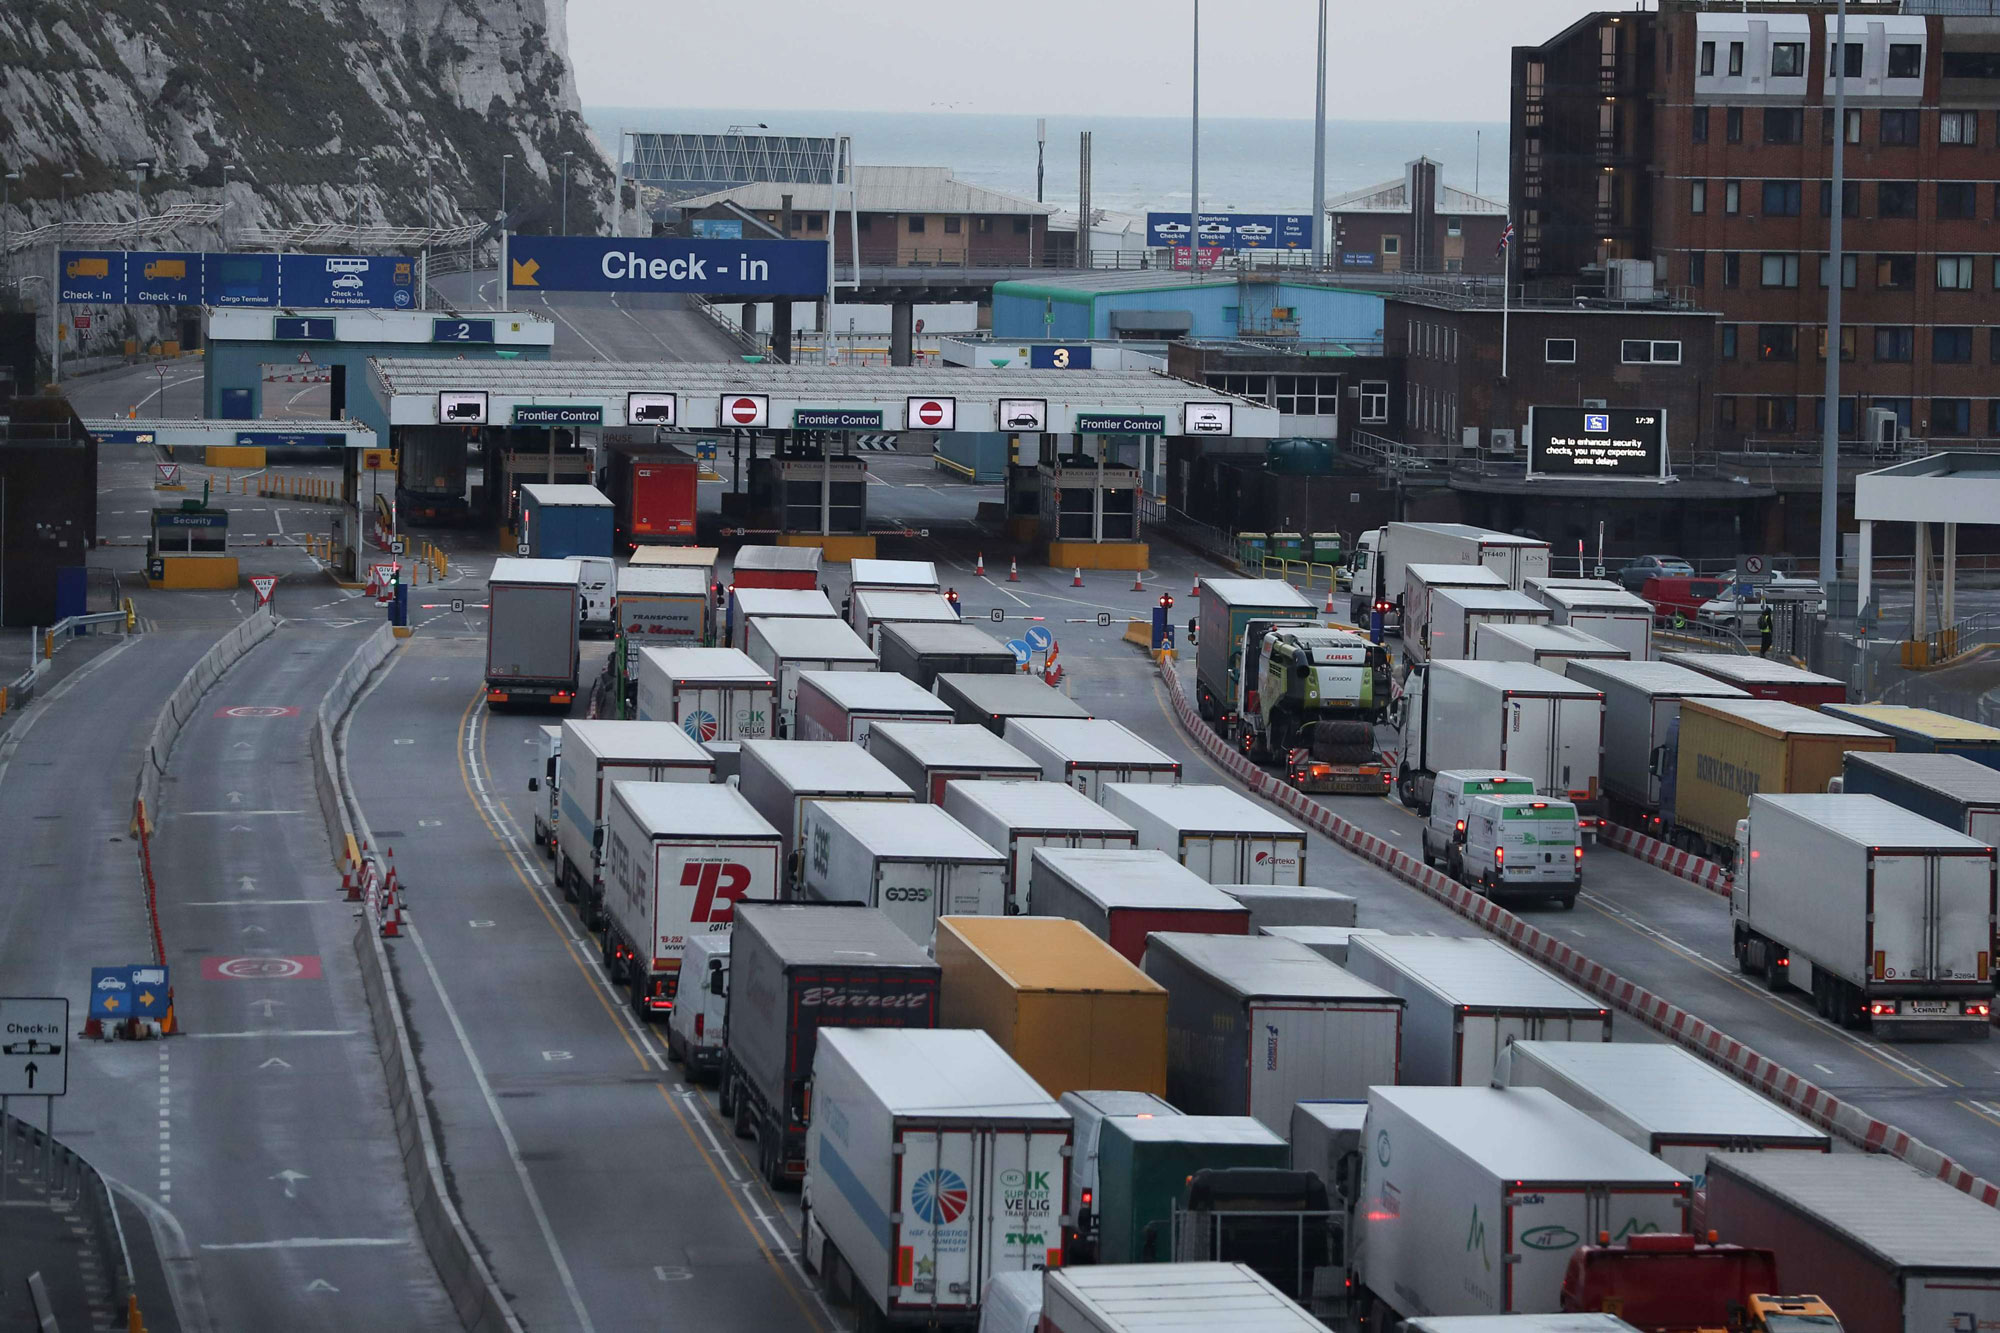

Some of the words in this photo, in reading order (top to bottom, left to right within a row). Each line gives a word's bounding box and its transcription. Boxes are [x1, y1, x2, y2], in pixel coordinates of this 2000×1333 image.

[601, 251, 707, 280] Check
[740, 253, 768, 281] in
[62, 290, 93, 300] Check
[102, 291, 112, 299] In
[138, 291, 169, 301] Check
[178, 292, 187, 301] In
[301, 321, 310, 337] 1
[458, 323, 469, 339] 2
[1053, 348, 1070, 368] 3
[517, 411, 558, 420] Frontier
[560, 410, 600, 421] Control
[798, 415, 839, 424] Frontier
[841, 415, 880, 425] Control
[1080, 419, 1121, 429] Frontier
[1123, 420, 1162, 430] Control
[1551, 437, 1566, 445] Due
[1577, 438, 1610, 446] enhanced
[1613, 440, 1642, 448] security
[1546, 447, 1572, 456] checks,
[1595, 457, 1618, 466] delays
[173, 517, 212, 525] Security
[802, 987, 927, 1007] Barrett
[7, 1024, 59, 1033] Check-in
[1027, 1172, 1050, 1190] IK
[1005, 1200, 1050, 1210] VELIG
[1005, 1233, 1045, 1244] TVM
